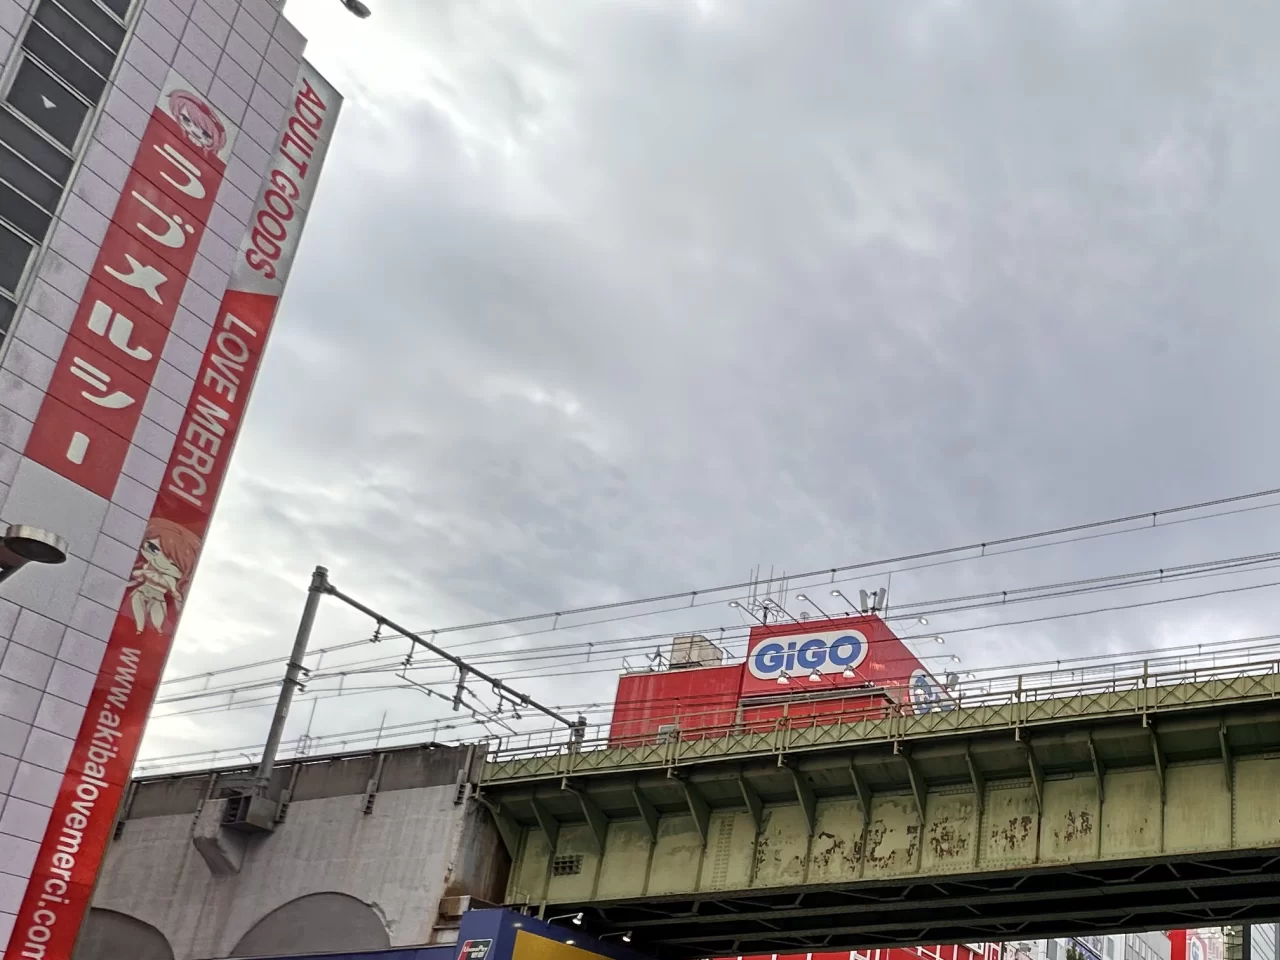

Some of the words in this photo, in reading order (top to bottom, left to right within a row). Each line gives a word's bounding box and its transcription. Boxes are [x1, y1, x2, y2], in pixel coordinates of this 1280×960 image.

[277, 77, 328, 180] ADULT
[245, 173, 301, 280] GOODS
[204, 311, 258, 406] LOVE
[167, 394, 228, 507] MERCI
